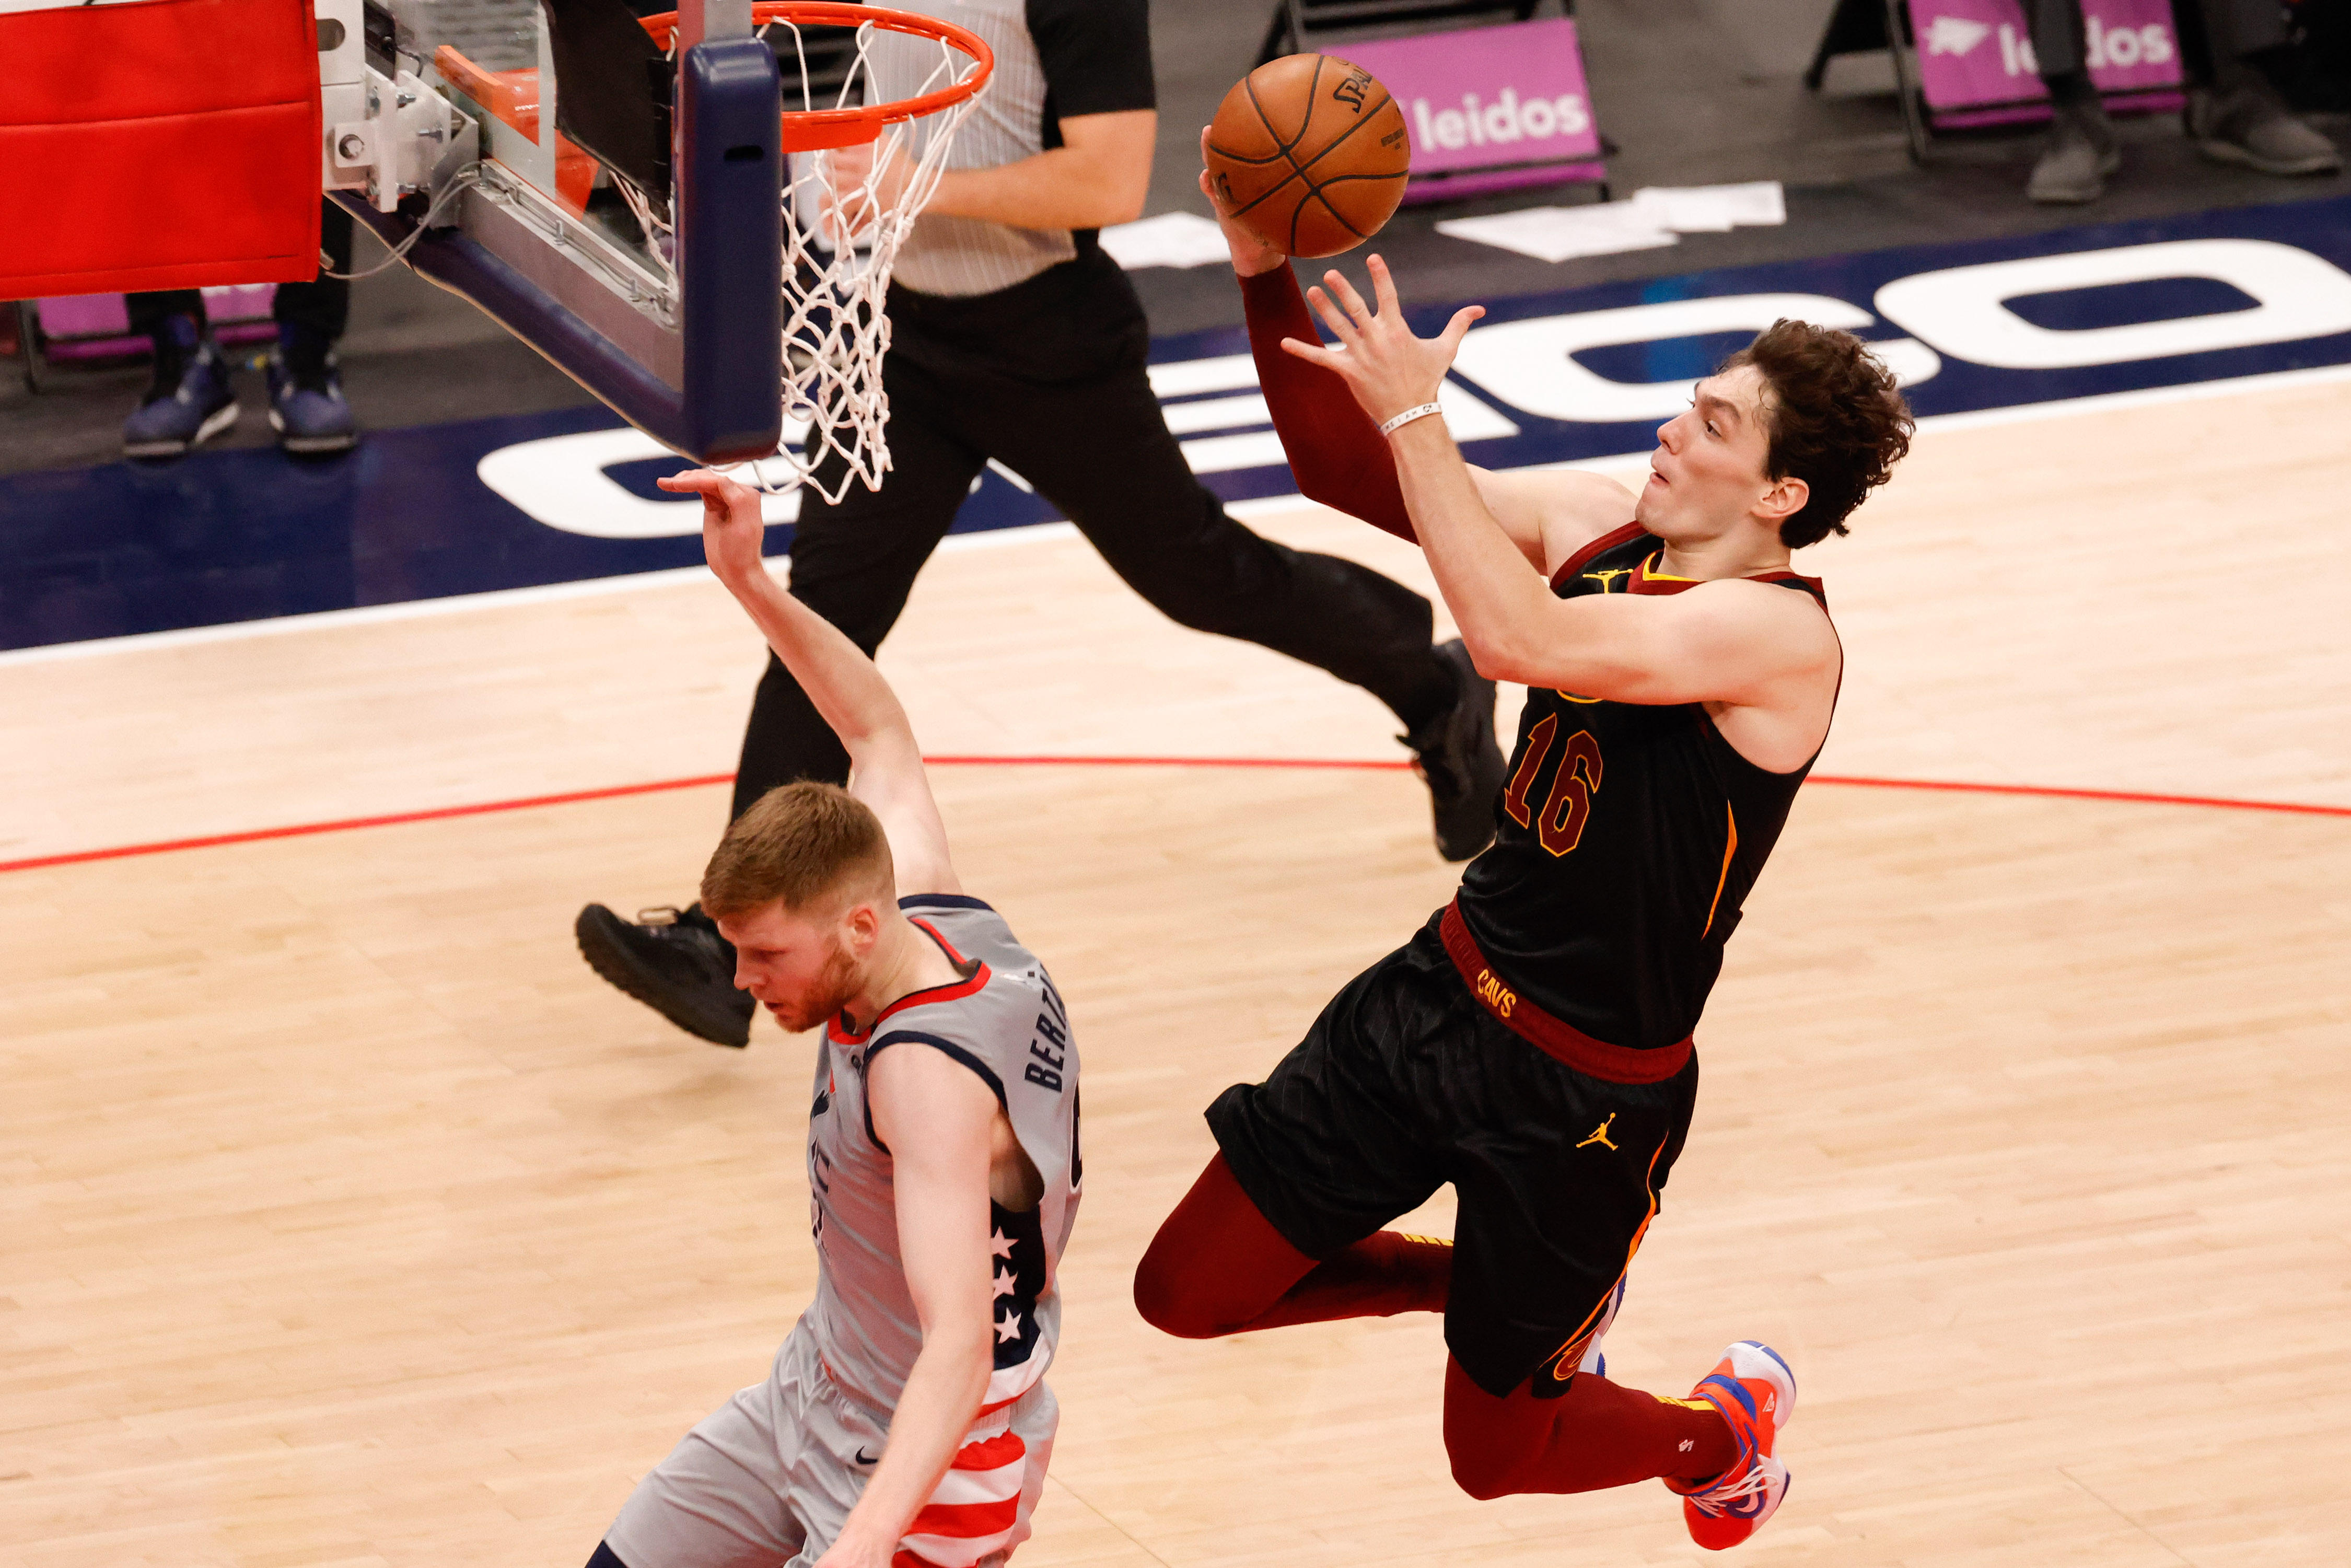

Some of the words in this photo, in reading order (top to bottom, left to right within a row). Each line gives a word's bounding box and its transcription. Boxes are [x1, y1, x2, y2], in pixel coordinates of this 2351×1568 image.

[1413, 86, 1589, 151] leidos
[1504, 712, 1603, 857] 16
[1477, 969, 1516, 1018] CAVS
